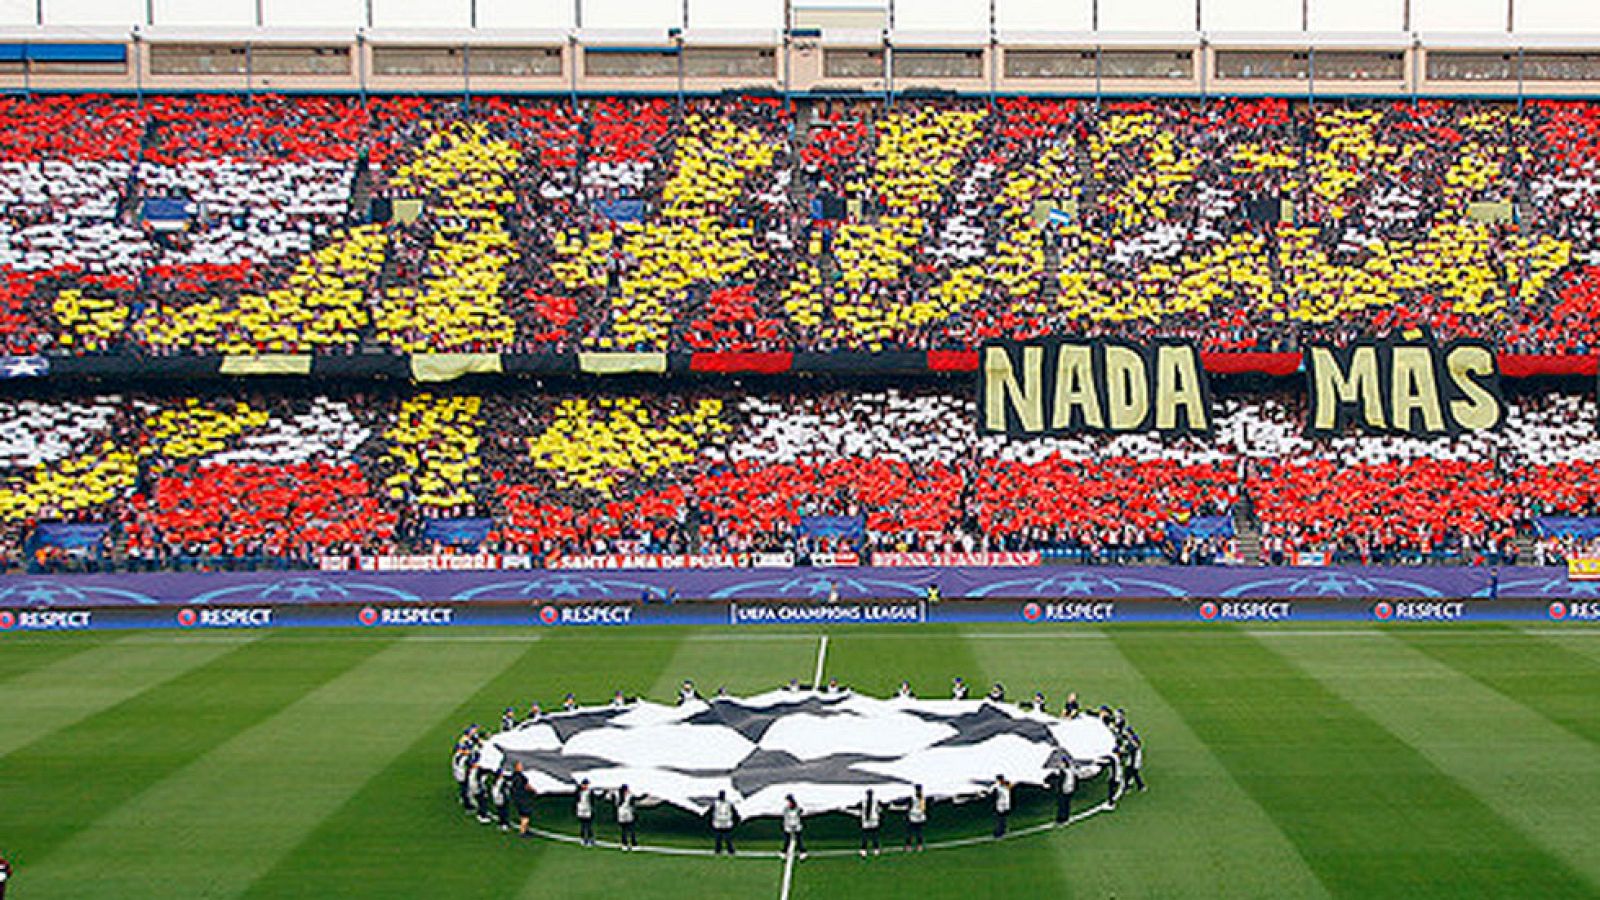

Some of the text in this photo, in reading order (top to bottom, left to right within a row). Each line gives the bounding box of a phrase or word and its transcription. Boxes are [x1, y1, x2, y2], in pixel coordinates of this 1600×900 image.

[985, 344, 1208, 432] NADA
[561, 554, 617, 569] SANTA
[621, 554, 658, 569] ANA
[19, 611, 91, 626] RESPECT
[200, 609, 272, 625] RESPECT
[382, 608, 453, 623] RESPECT
[562, 606, 632, 622] RESPECT
[738, 605, 917, 620] UEFA CHAMPIONS LEAGUE
[1045, 603, 1113, 619] RESPECT
[1221, 602, 1289, 619] RESPECT
[1396, 602, 1464, 619] RESPECT
